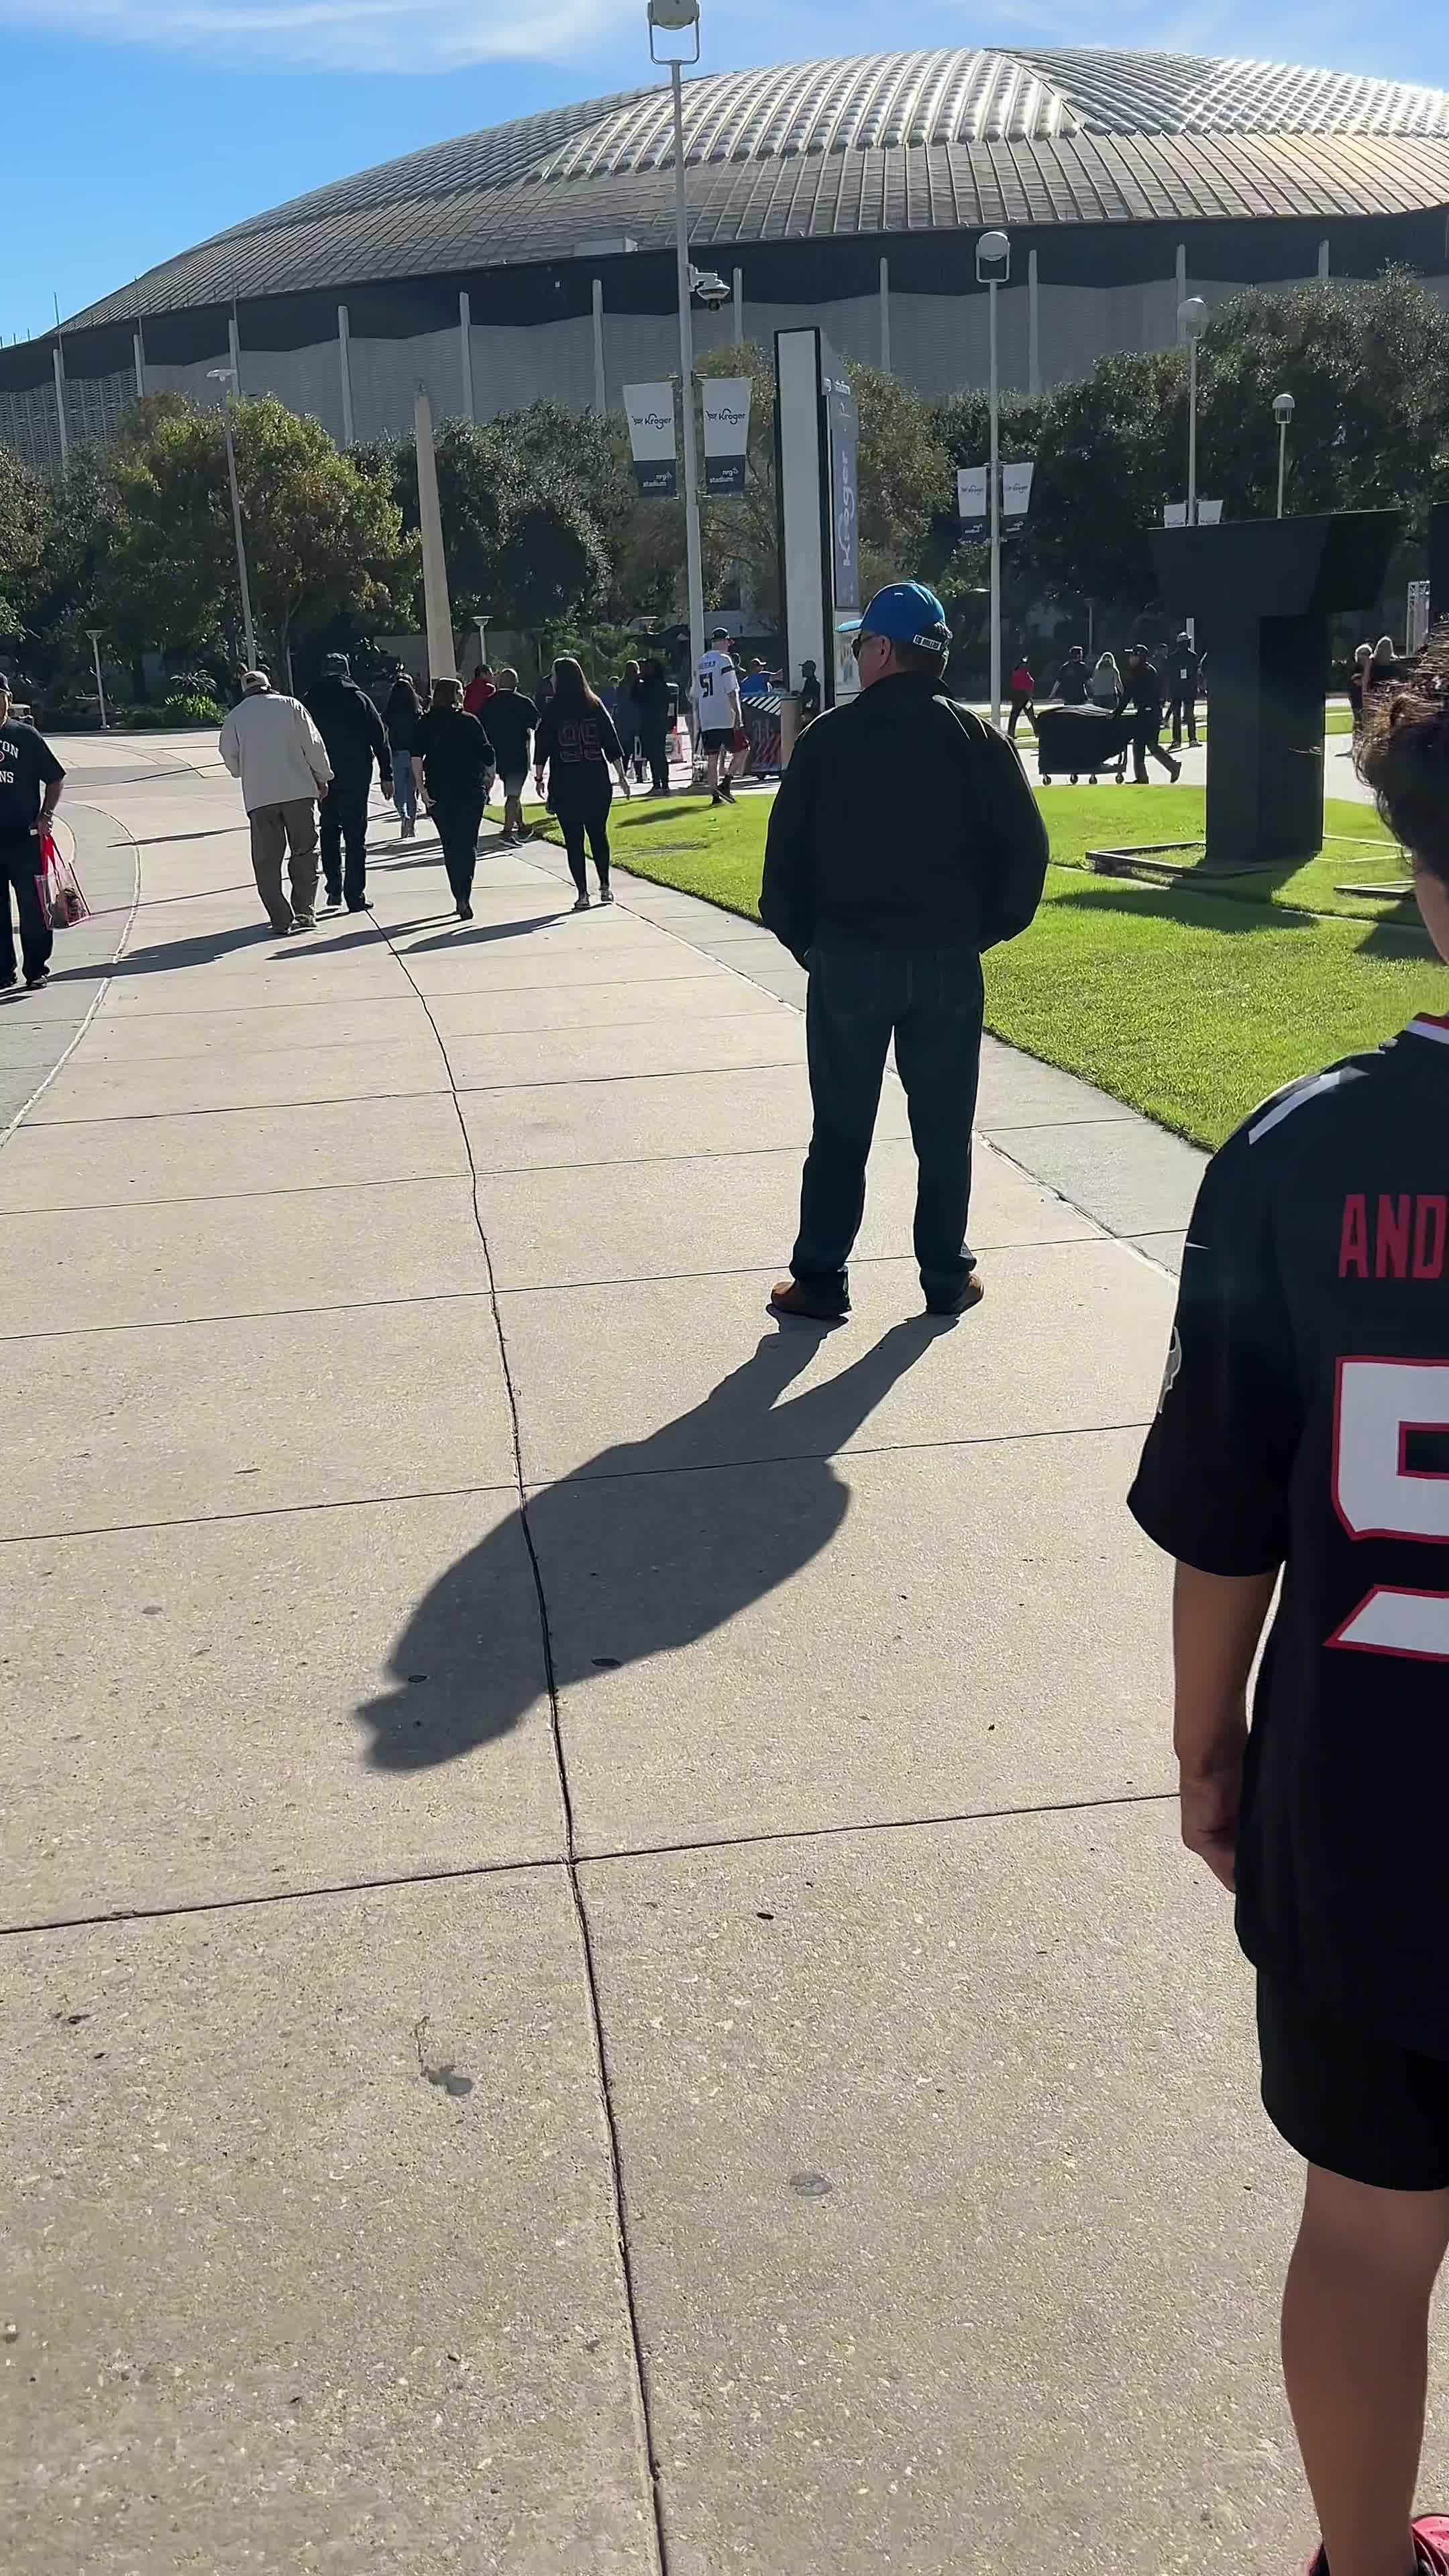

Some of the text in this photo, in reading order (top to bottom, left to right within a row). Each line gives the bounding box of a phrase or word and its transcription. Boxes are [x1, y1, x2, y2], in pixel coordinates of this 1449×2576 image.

[645, 413, 672, 429] Kroger
[718, 408, 745, 425] Kroger
[839, 451, 855, 566] Kroger
[699, 672, 713, 698] 51
[0, 740, 19, 759] ON
